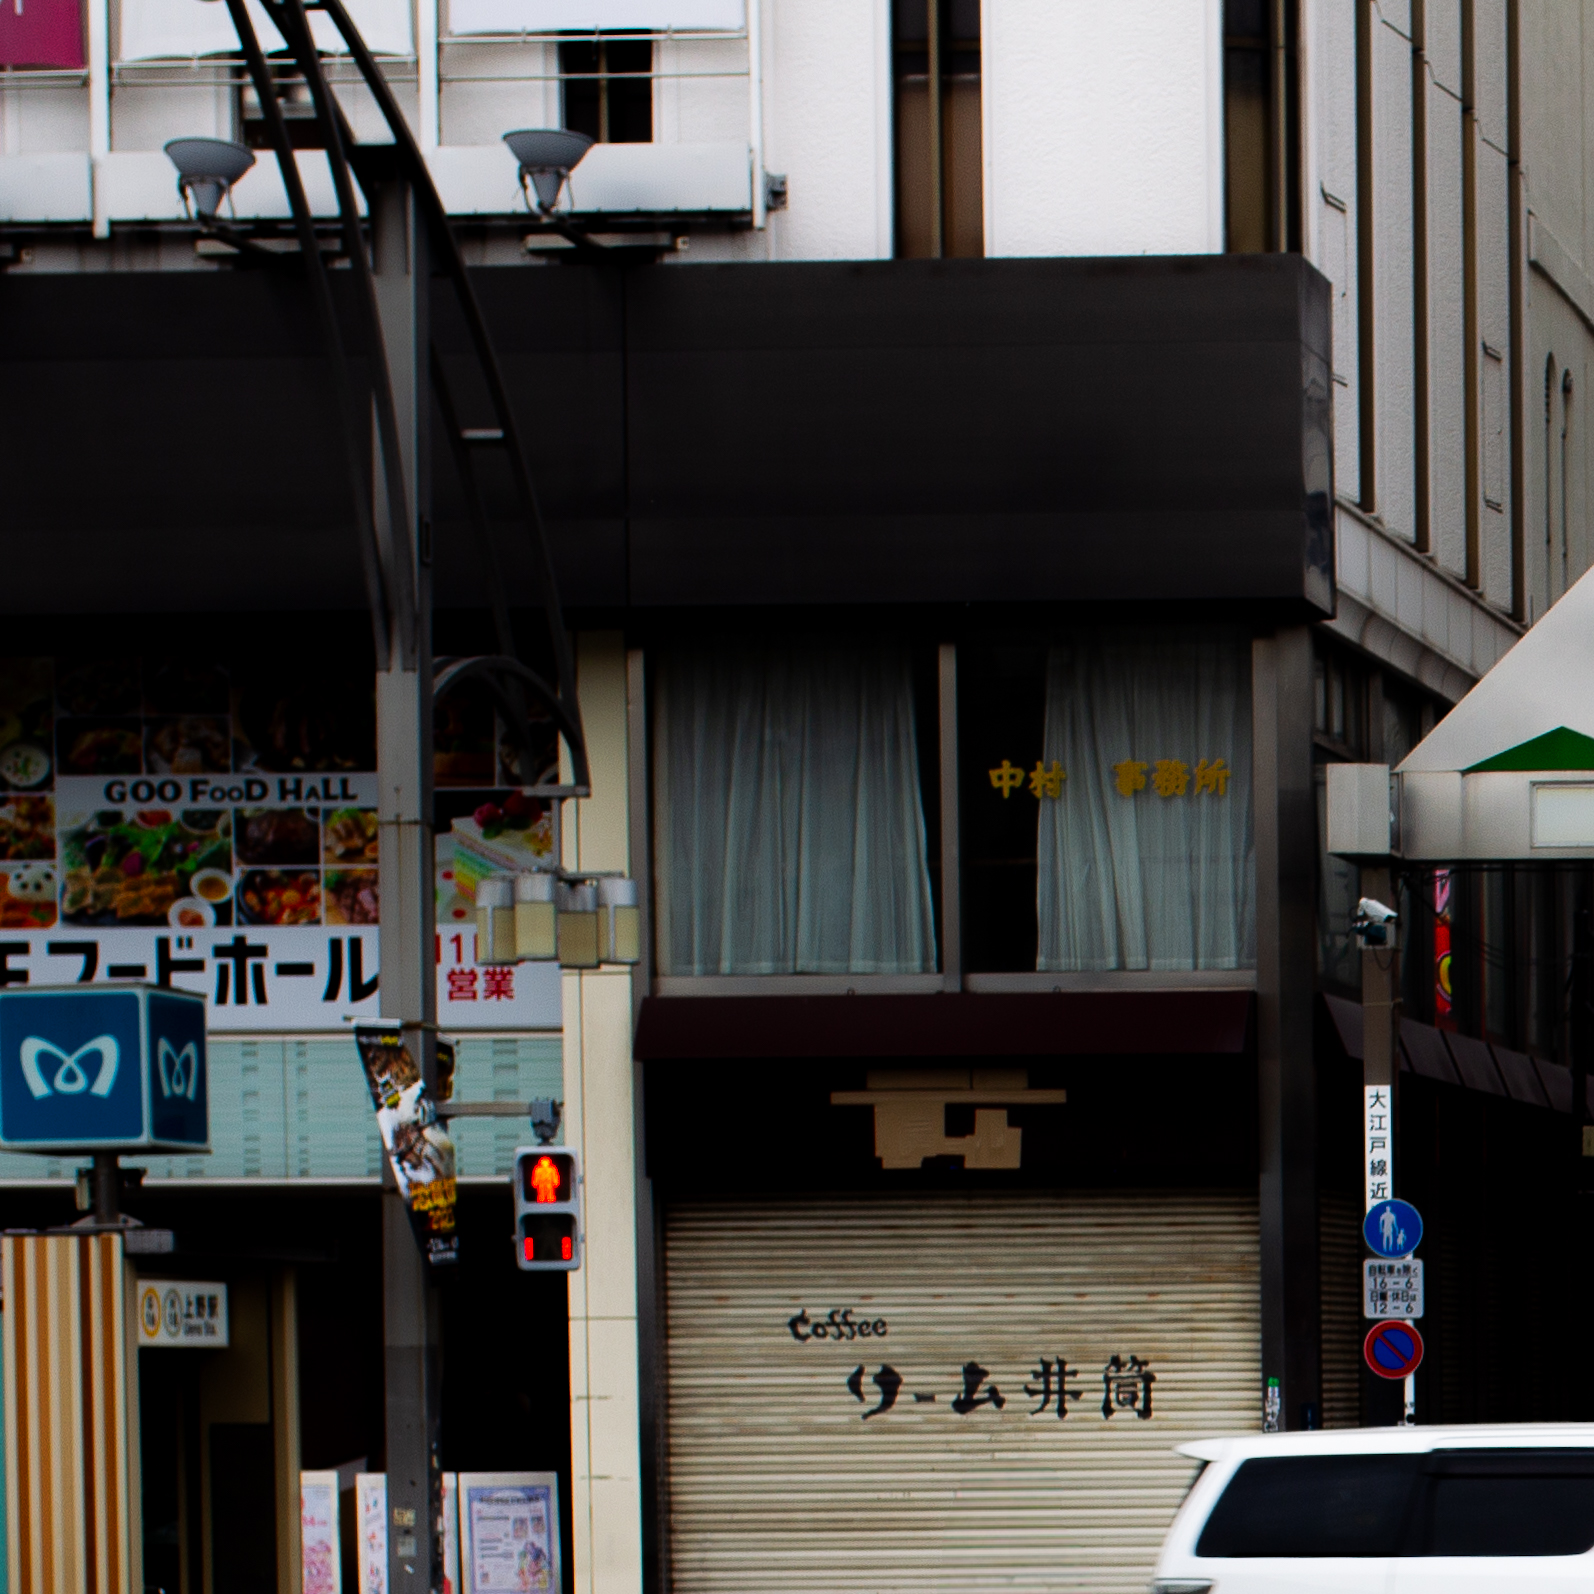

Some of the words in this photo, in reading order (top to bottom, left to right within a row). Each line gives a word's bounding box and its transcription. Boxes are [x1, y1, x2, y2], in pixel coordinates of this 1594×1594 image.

[103, 778, 183, 804] GOO
[988, 760, 1067, 800] 中村
[1112, 759, 1232, 799] 事務所
[447, 967, 515, 1001] 営業
[1368, 1089, 1388, 1201] 大江戸線近
[787, 1308, 889, 1342] Coffee
